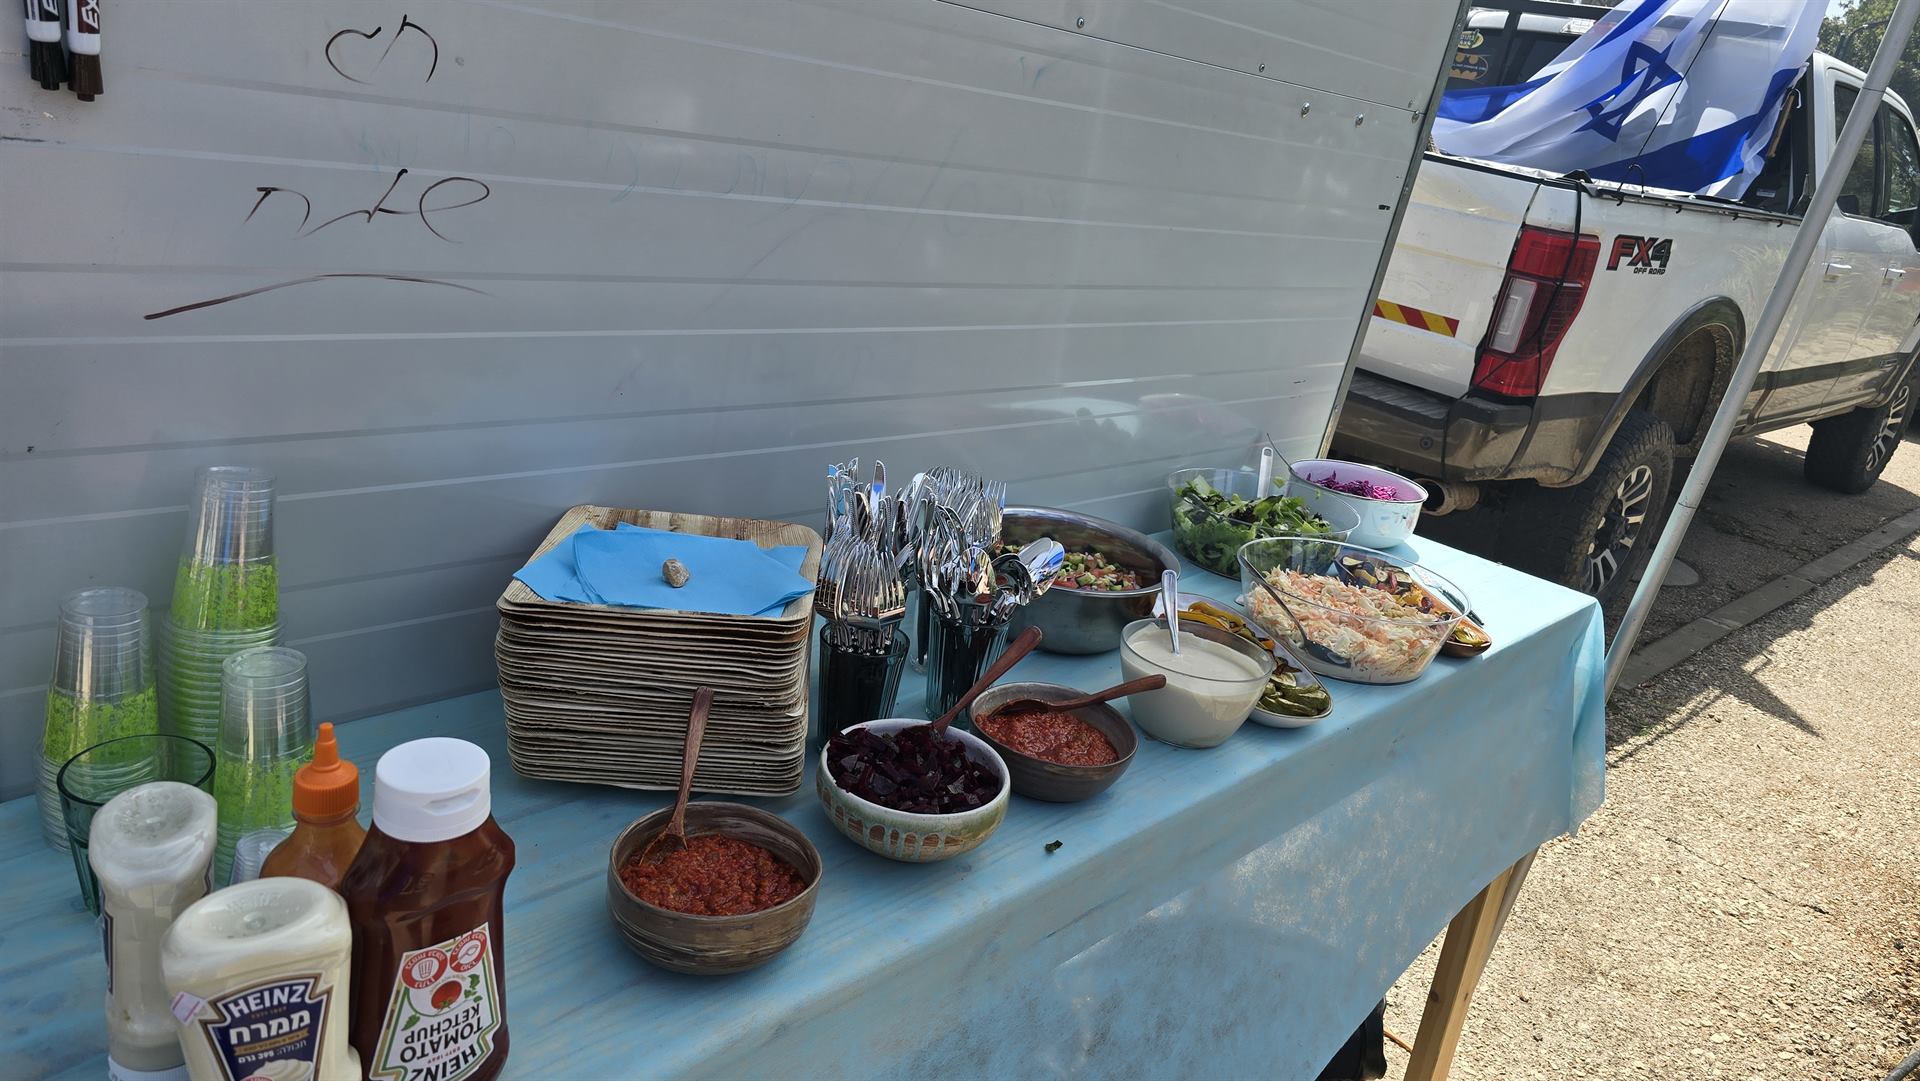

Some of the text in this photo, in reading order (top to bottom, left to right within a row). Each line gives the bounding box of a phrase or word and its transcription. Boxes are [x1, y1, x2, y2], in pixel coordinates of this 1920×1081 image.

[1606, 234, 1674, 271] FX4
[1633, 267, 1647, 275] OFF
[228, 985, 306, 1018] HEINZ
[229, 1009, 311, 1045] ממרח
[400, 1016, 483, 1063] TOMATO
[404, 1003, 480, 1044] KETCHUP
[238, 1055, 257, 1064] גרם
